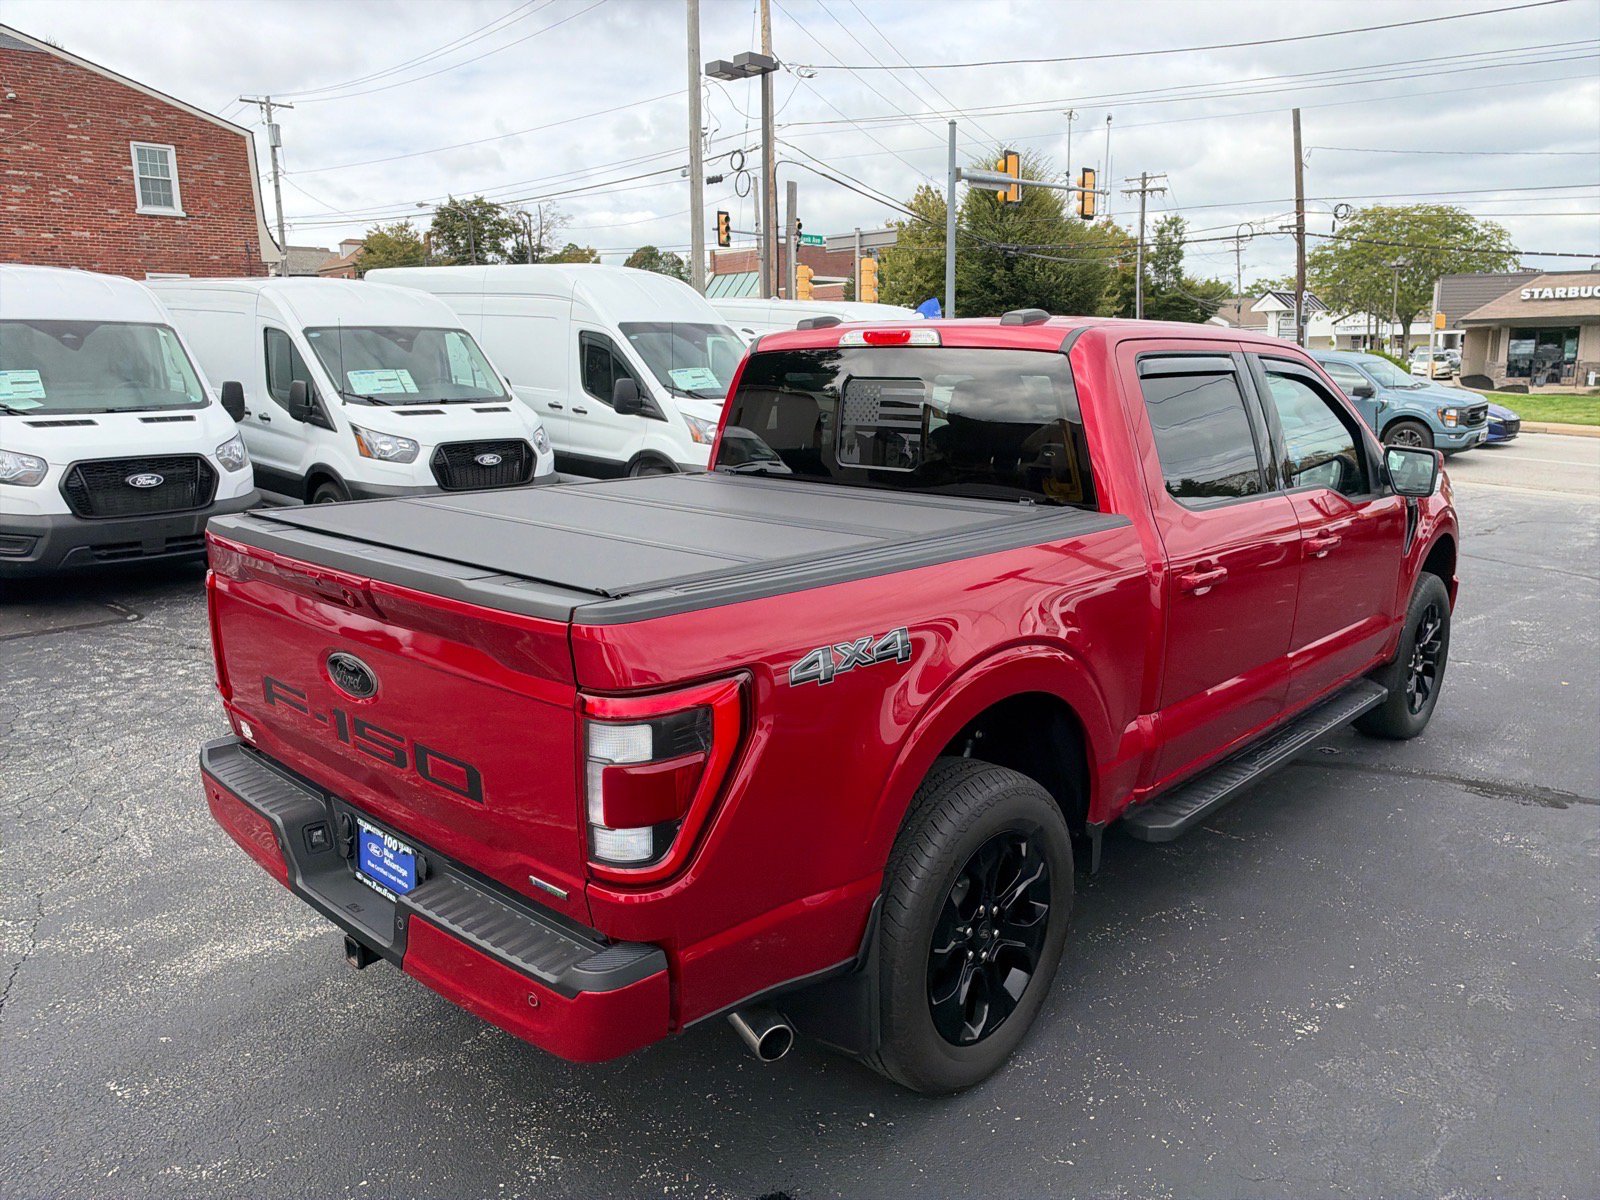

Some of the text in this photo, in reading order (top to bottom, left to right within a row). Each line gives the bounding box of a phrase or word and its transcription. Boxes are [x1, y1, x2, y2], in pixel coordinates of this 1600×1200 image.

[812, 236, 821, 244] Ave
[334, 658, 363, 690] Ford
[264, 676, 485, 804] F-150
[384, 834, 398, 851] 100
[384, 847, 394, 860] Blue
[384, 857, 408, 877] Advantage
